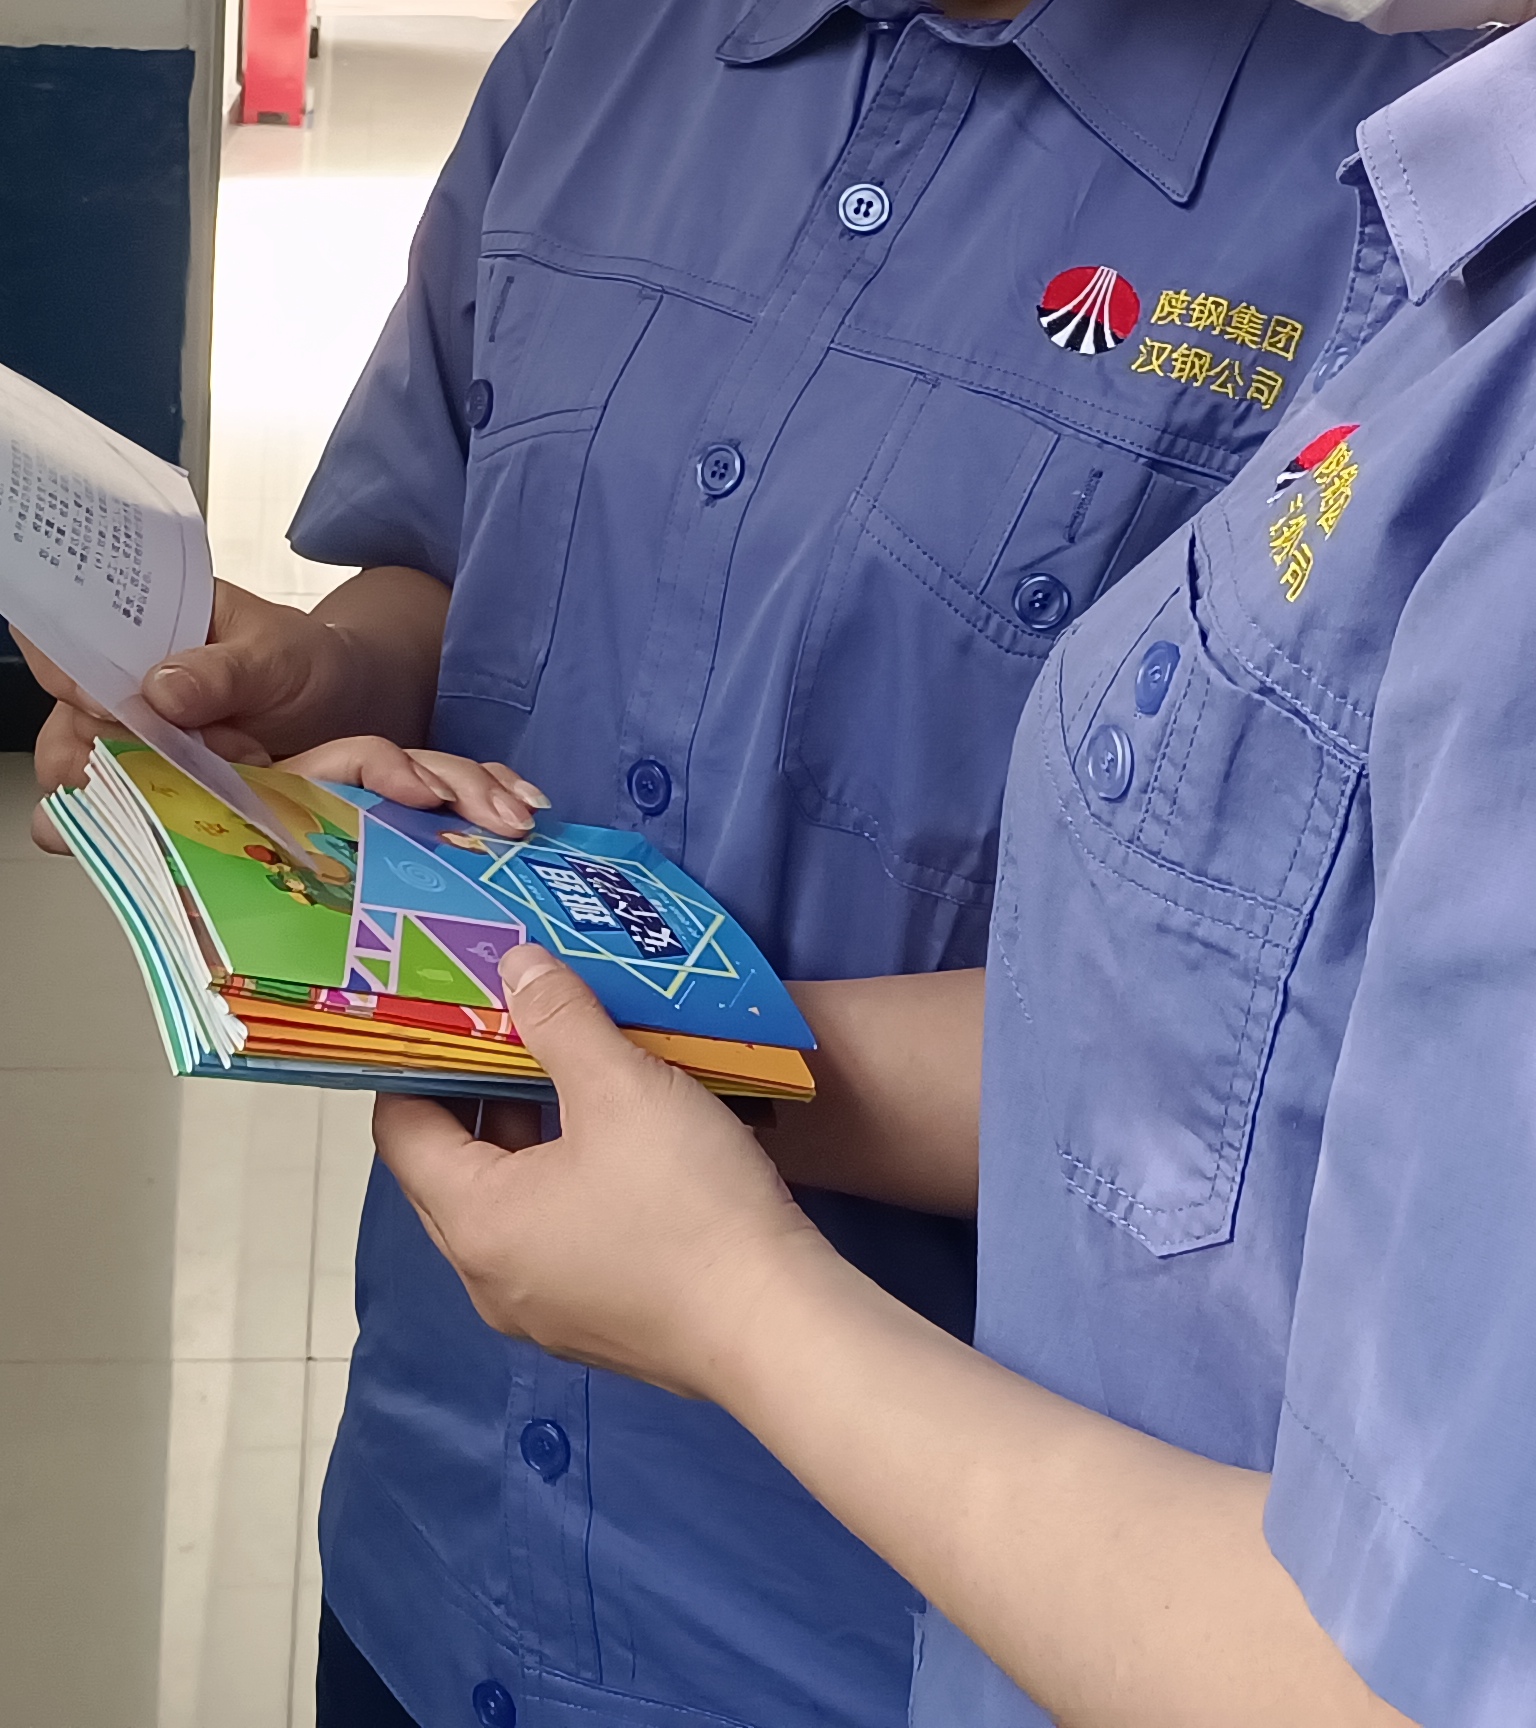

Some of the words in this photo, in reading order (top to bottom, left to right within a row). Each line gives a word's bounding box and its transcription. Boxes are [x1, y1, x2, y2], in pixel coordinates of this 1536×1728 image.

[1150, 288, 1303, 362] 陕钢集团
[1130, 337, 1285, 410] 汉钢公司
